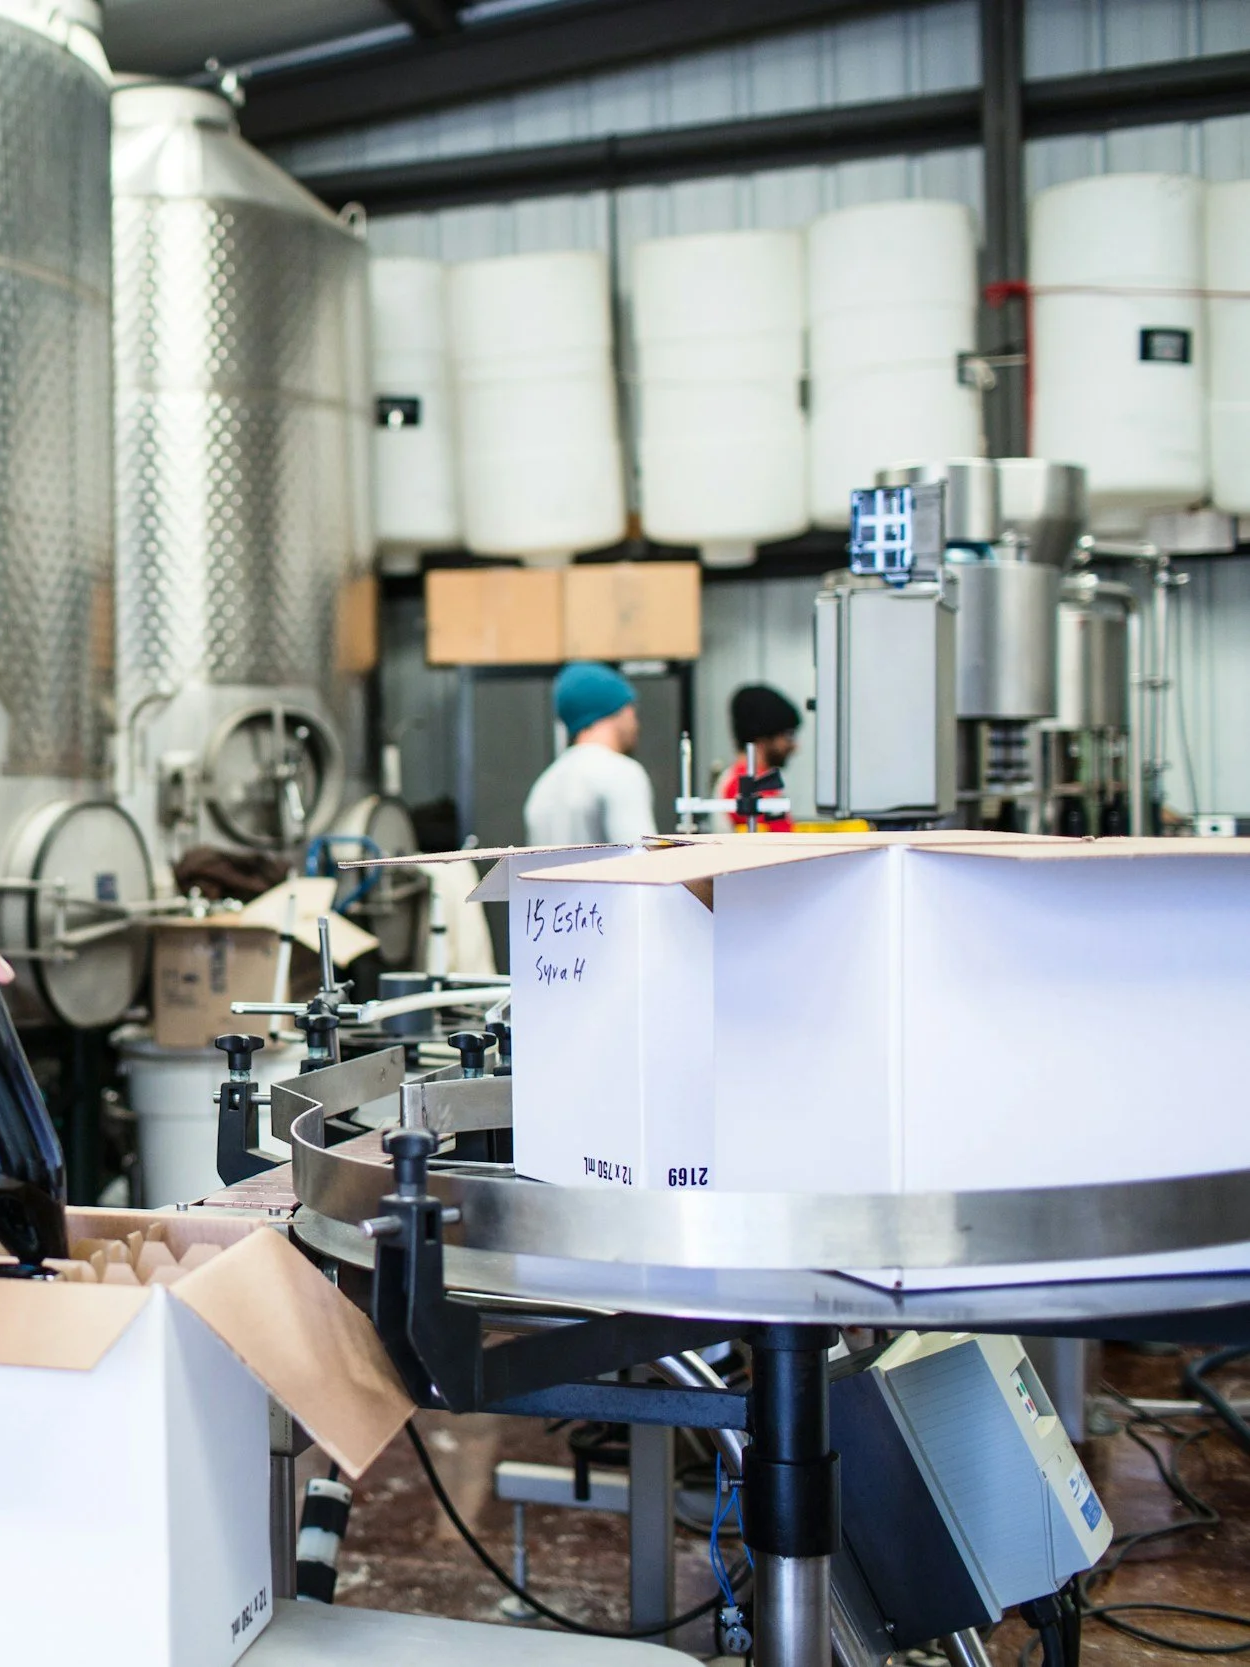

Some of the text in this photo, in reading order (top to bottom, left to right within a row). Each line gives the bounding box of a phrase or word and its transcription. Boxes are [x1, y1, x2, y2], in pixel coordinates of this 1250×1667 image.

[526, 898, 604, 942] 15 Estate
[583, 1156, 596, 1175] mL
[598, 1160, 613, 1181] 750
[622, 1166, 632, 1185] 12
[668, 1167, 708, 1187] 2169
[259, 1585, 267, 1612] 12
[242, 1601, 253, 1632] 750
